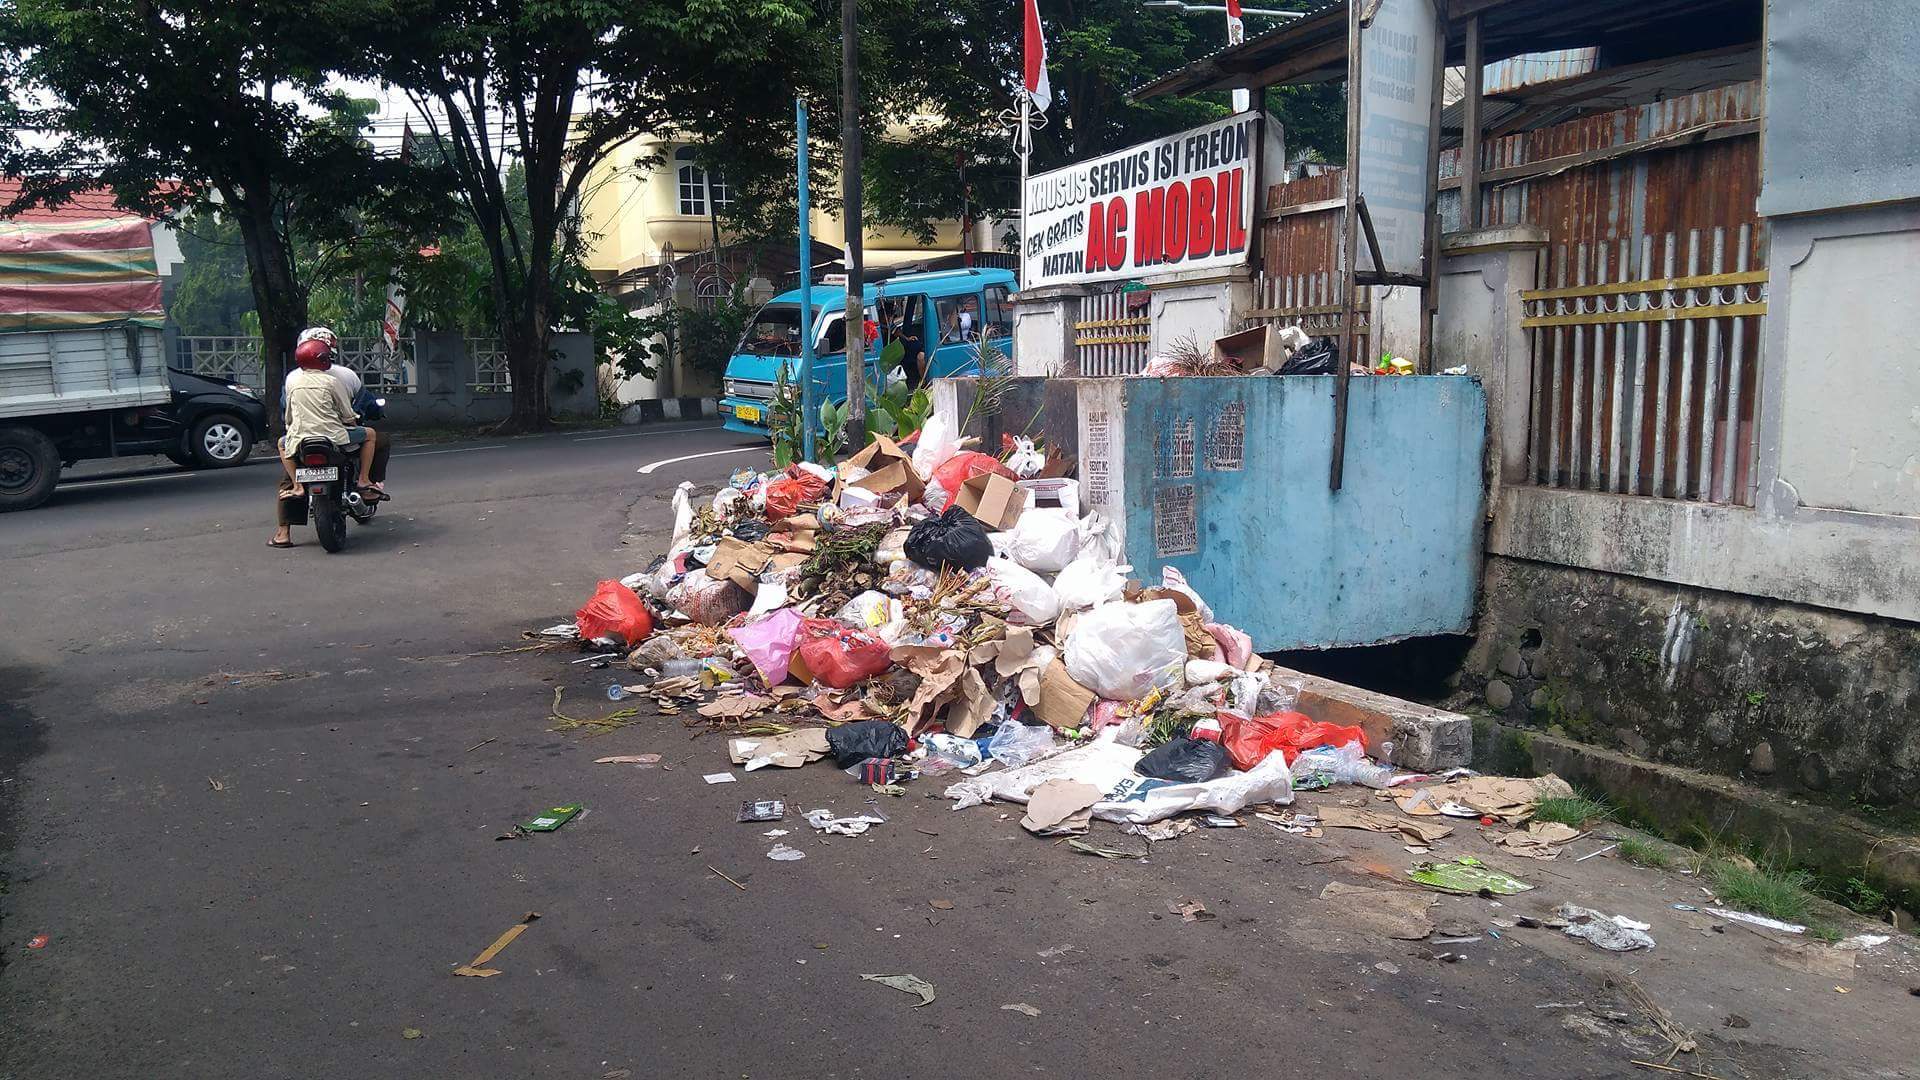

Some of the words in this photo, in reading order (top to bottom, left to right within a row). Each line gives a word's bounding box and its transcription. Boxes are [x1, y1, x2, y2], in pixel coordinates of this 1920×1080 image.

[1029, 171, 1087, 216] KHUSUS
[1089, 151, 1150, 198] SERVIS
[1153, 141, 1180, 180] ISI
[1184, 121, 1251, 174] FREON
[1027, 229, 1045, 258] CEK
[1047, 210, 1084, 248] GRATIS
[1085, 196, 1128, 274] AC
[1134, 167, 1247, 268] MOBIL
[1042, 250, 1084, 277] NATAN
